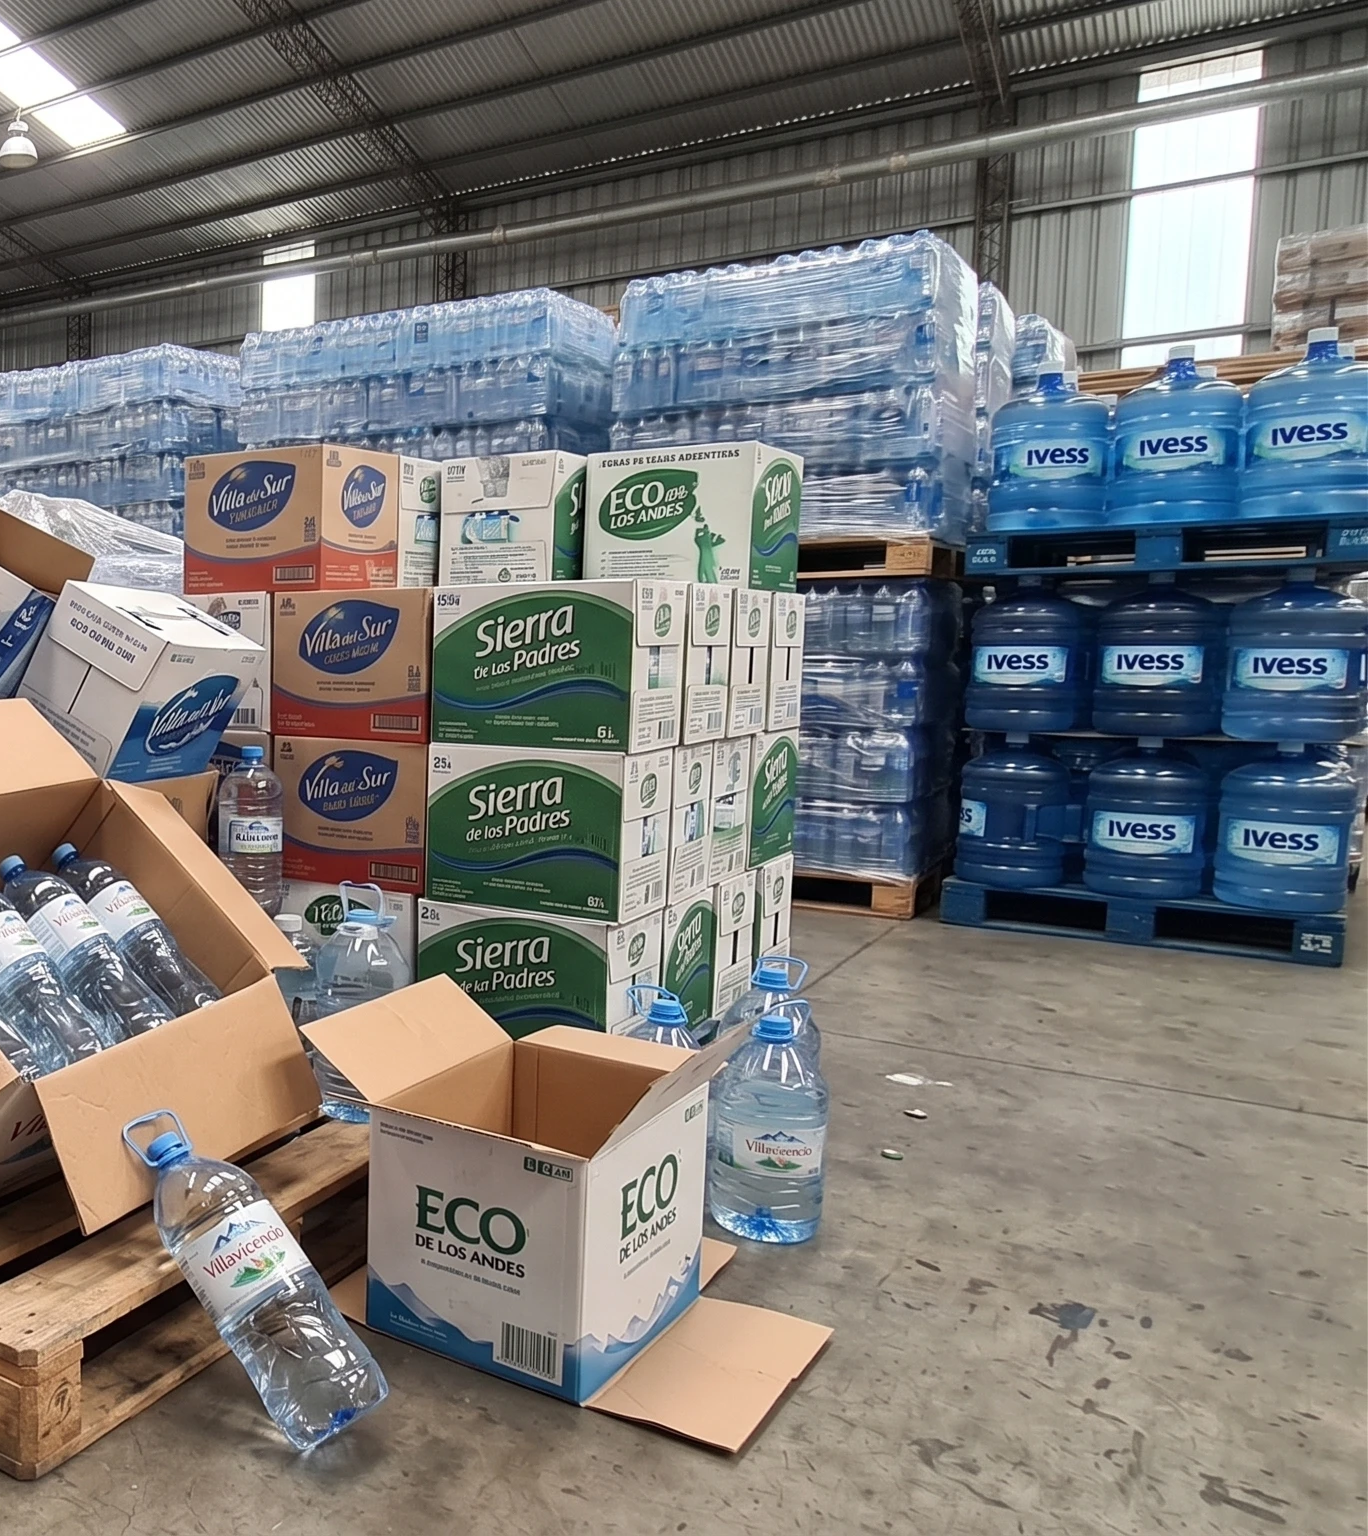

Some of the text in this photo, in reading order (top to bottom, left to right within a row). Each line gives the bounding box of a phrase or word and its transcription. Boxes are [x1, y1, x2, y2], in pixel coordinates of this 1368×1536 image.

[260, 473, 292, 498] Sur
[609, 481, 664, 516] ECO
[611, 502, 684, 529] LOS ANDES
[304, 621, 341, 657] Villa
[358, 615, 392, 641] Sur
[475, 604, 574, 658] Sierra
[513, 639, 581, 671] Padres
[305, 764, 339, 801] Villa
[357, 766, 392, 790] Sur
[468, 776, 563, 821] Sierra
[466, 809, 571, 842] de los Padres
[455, 936, 551, 973] Sierra
[492, 967, 555, 991] Padres
[621, 1154, 679, 1241] ECO
[415, 1185, 527, 1255] ECO
[619, 1207, 677, 1264] DE LOS ANDES
[202, 1224, 284, 1279] Villavicencio
[415, 1233, 434, 1250] DE
[438, 1240, 467, 1260] LOS
[470, 1253, 526, 1279] ANDES
